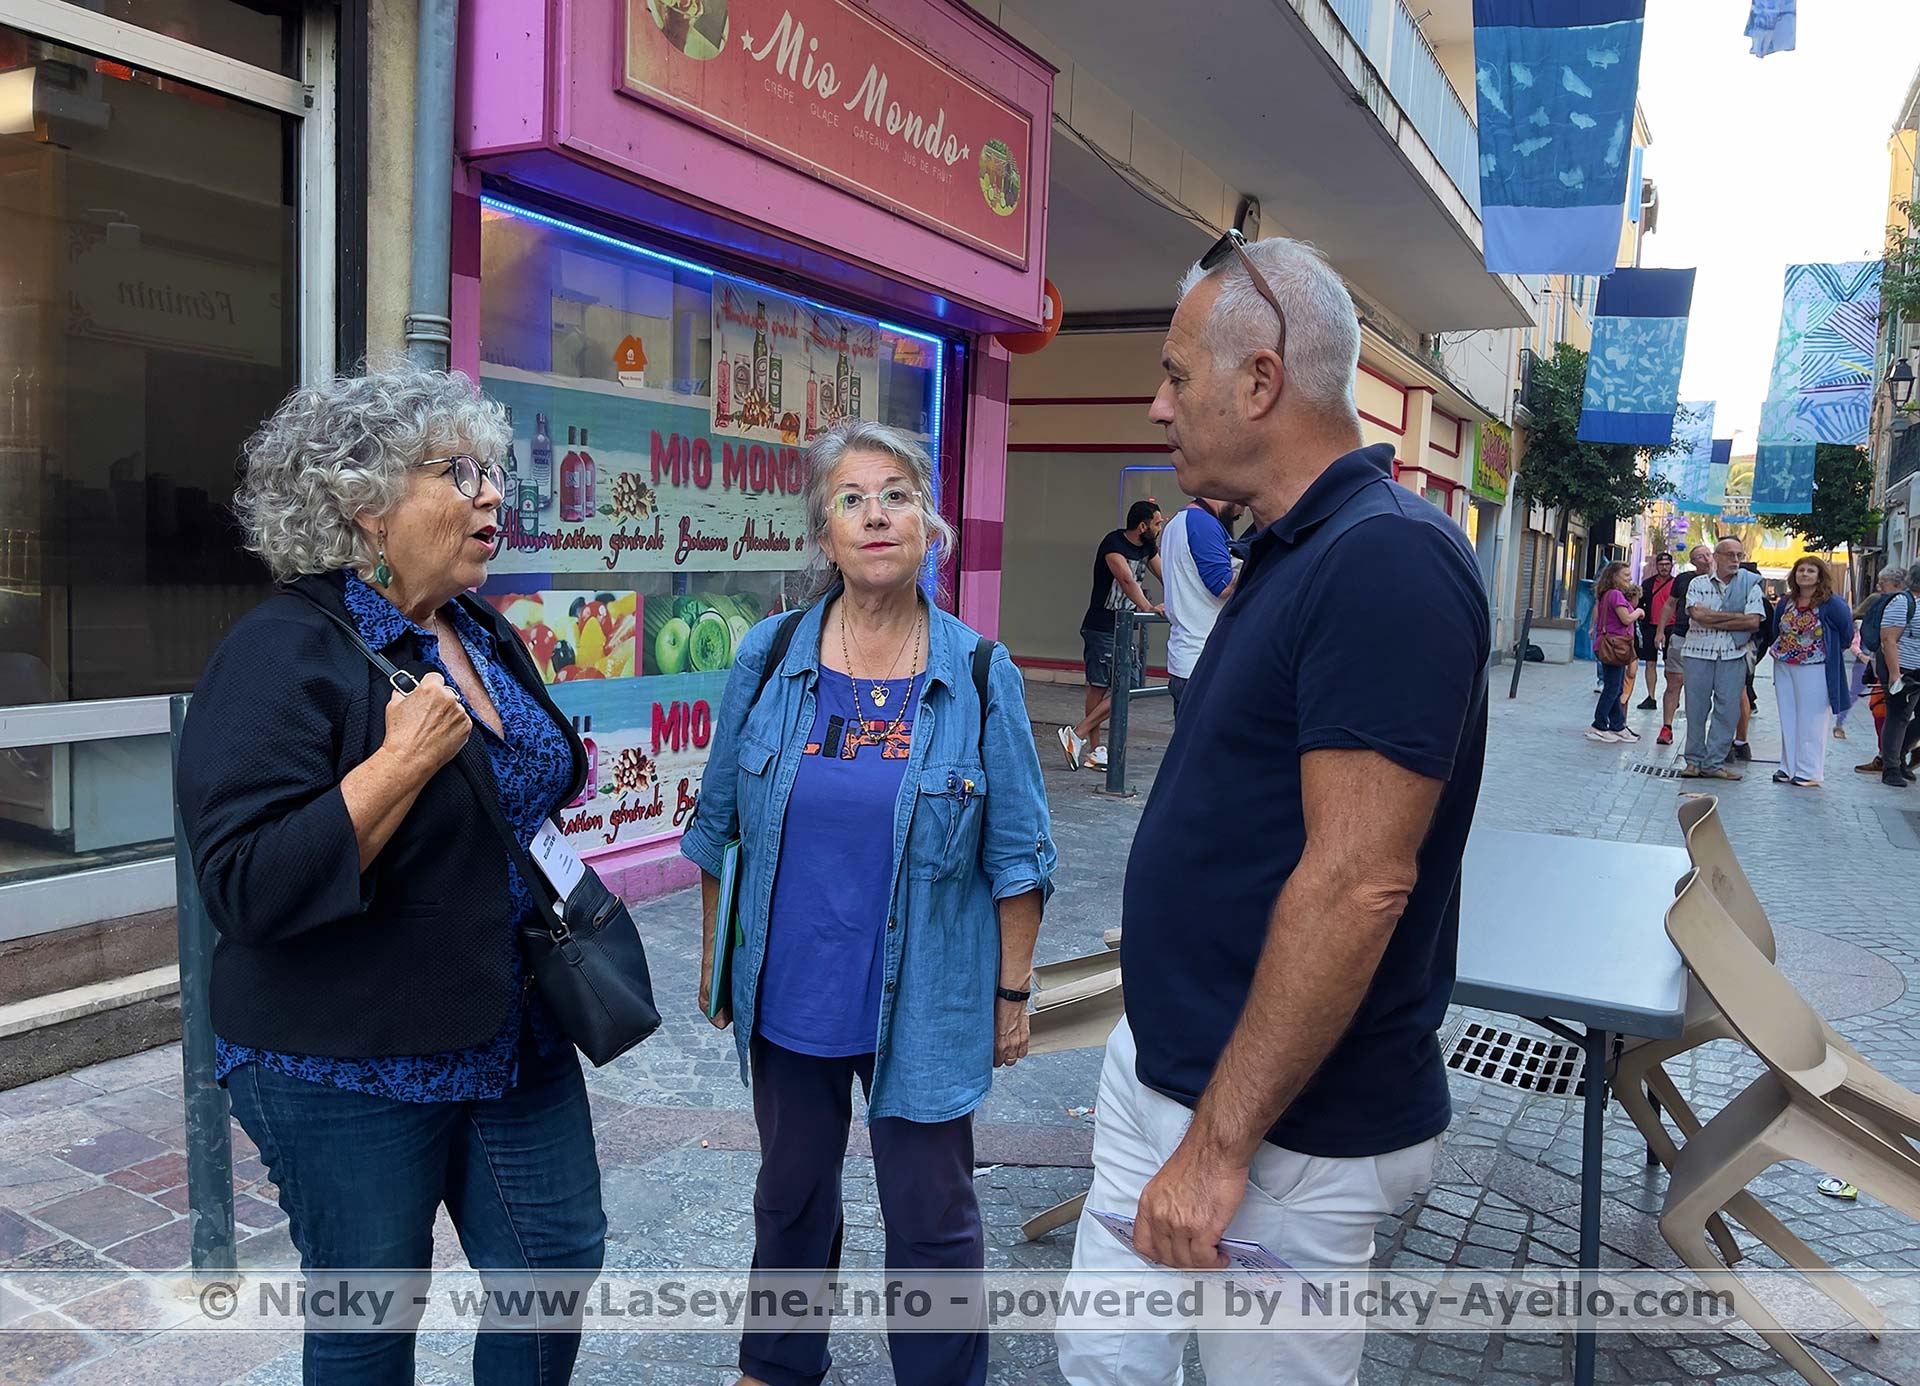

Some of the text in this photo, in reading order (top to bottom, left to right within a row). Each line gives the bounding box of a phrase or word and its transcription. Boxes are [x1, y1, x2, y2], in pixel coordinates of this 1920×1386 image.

[751, 9, 963, 166] Mio Mondo
[651, 430, 712, 489] MIO
[674, 514, 729, 566] Boissons
[651, 699, 711, 755] MIO
